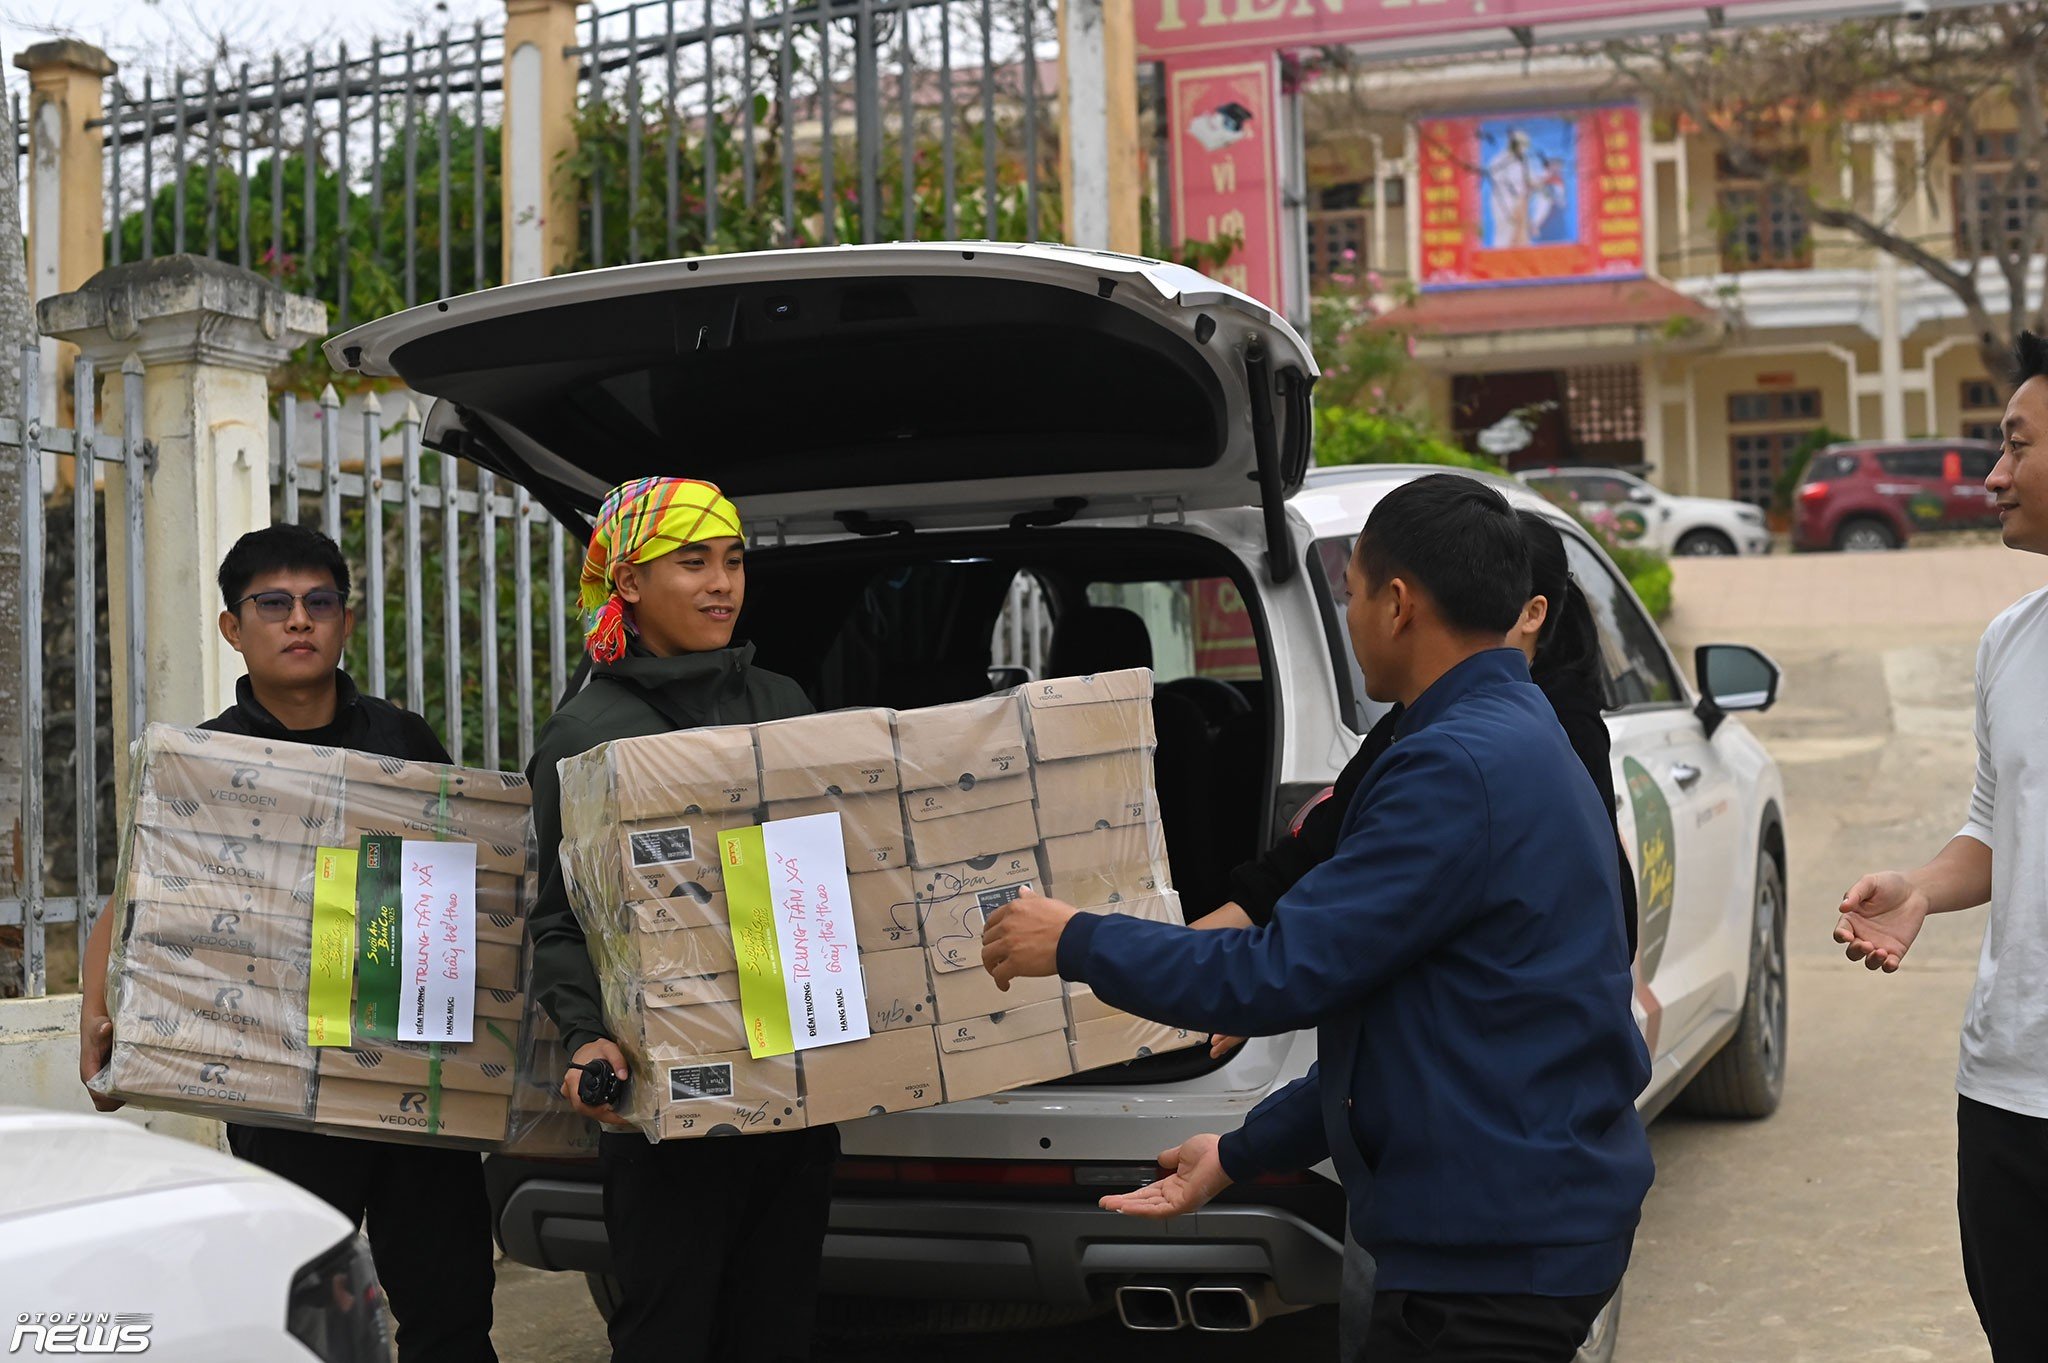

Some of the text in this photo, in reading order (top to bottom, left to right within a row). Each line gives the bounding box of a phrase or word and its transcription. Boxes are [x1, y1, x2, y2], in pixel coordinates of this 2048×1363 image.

[209, 788, 278, 808] VEDOOEN
[199, 863, 266, 880] VEDOOEN
[189, 934, 257, 951] VEDOOEN
[192, 1008, 261, 1027] VEDOOEN
[177, 1083, 247, 1103] VEDOOEN
